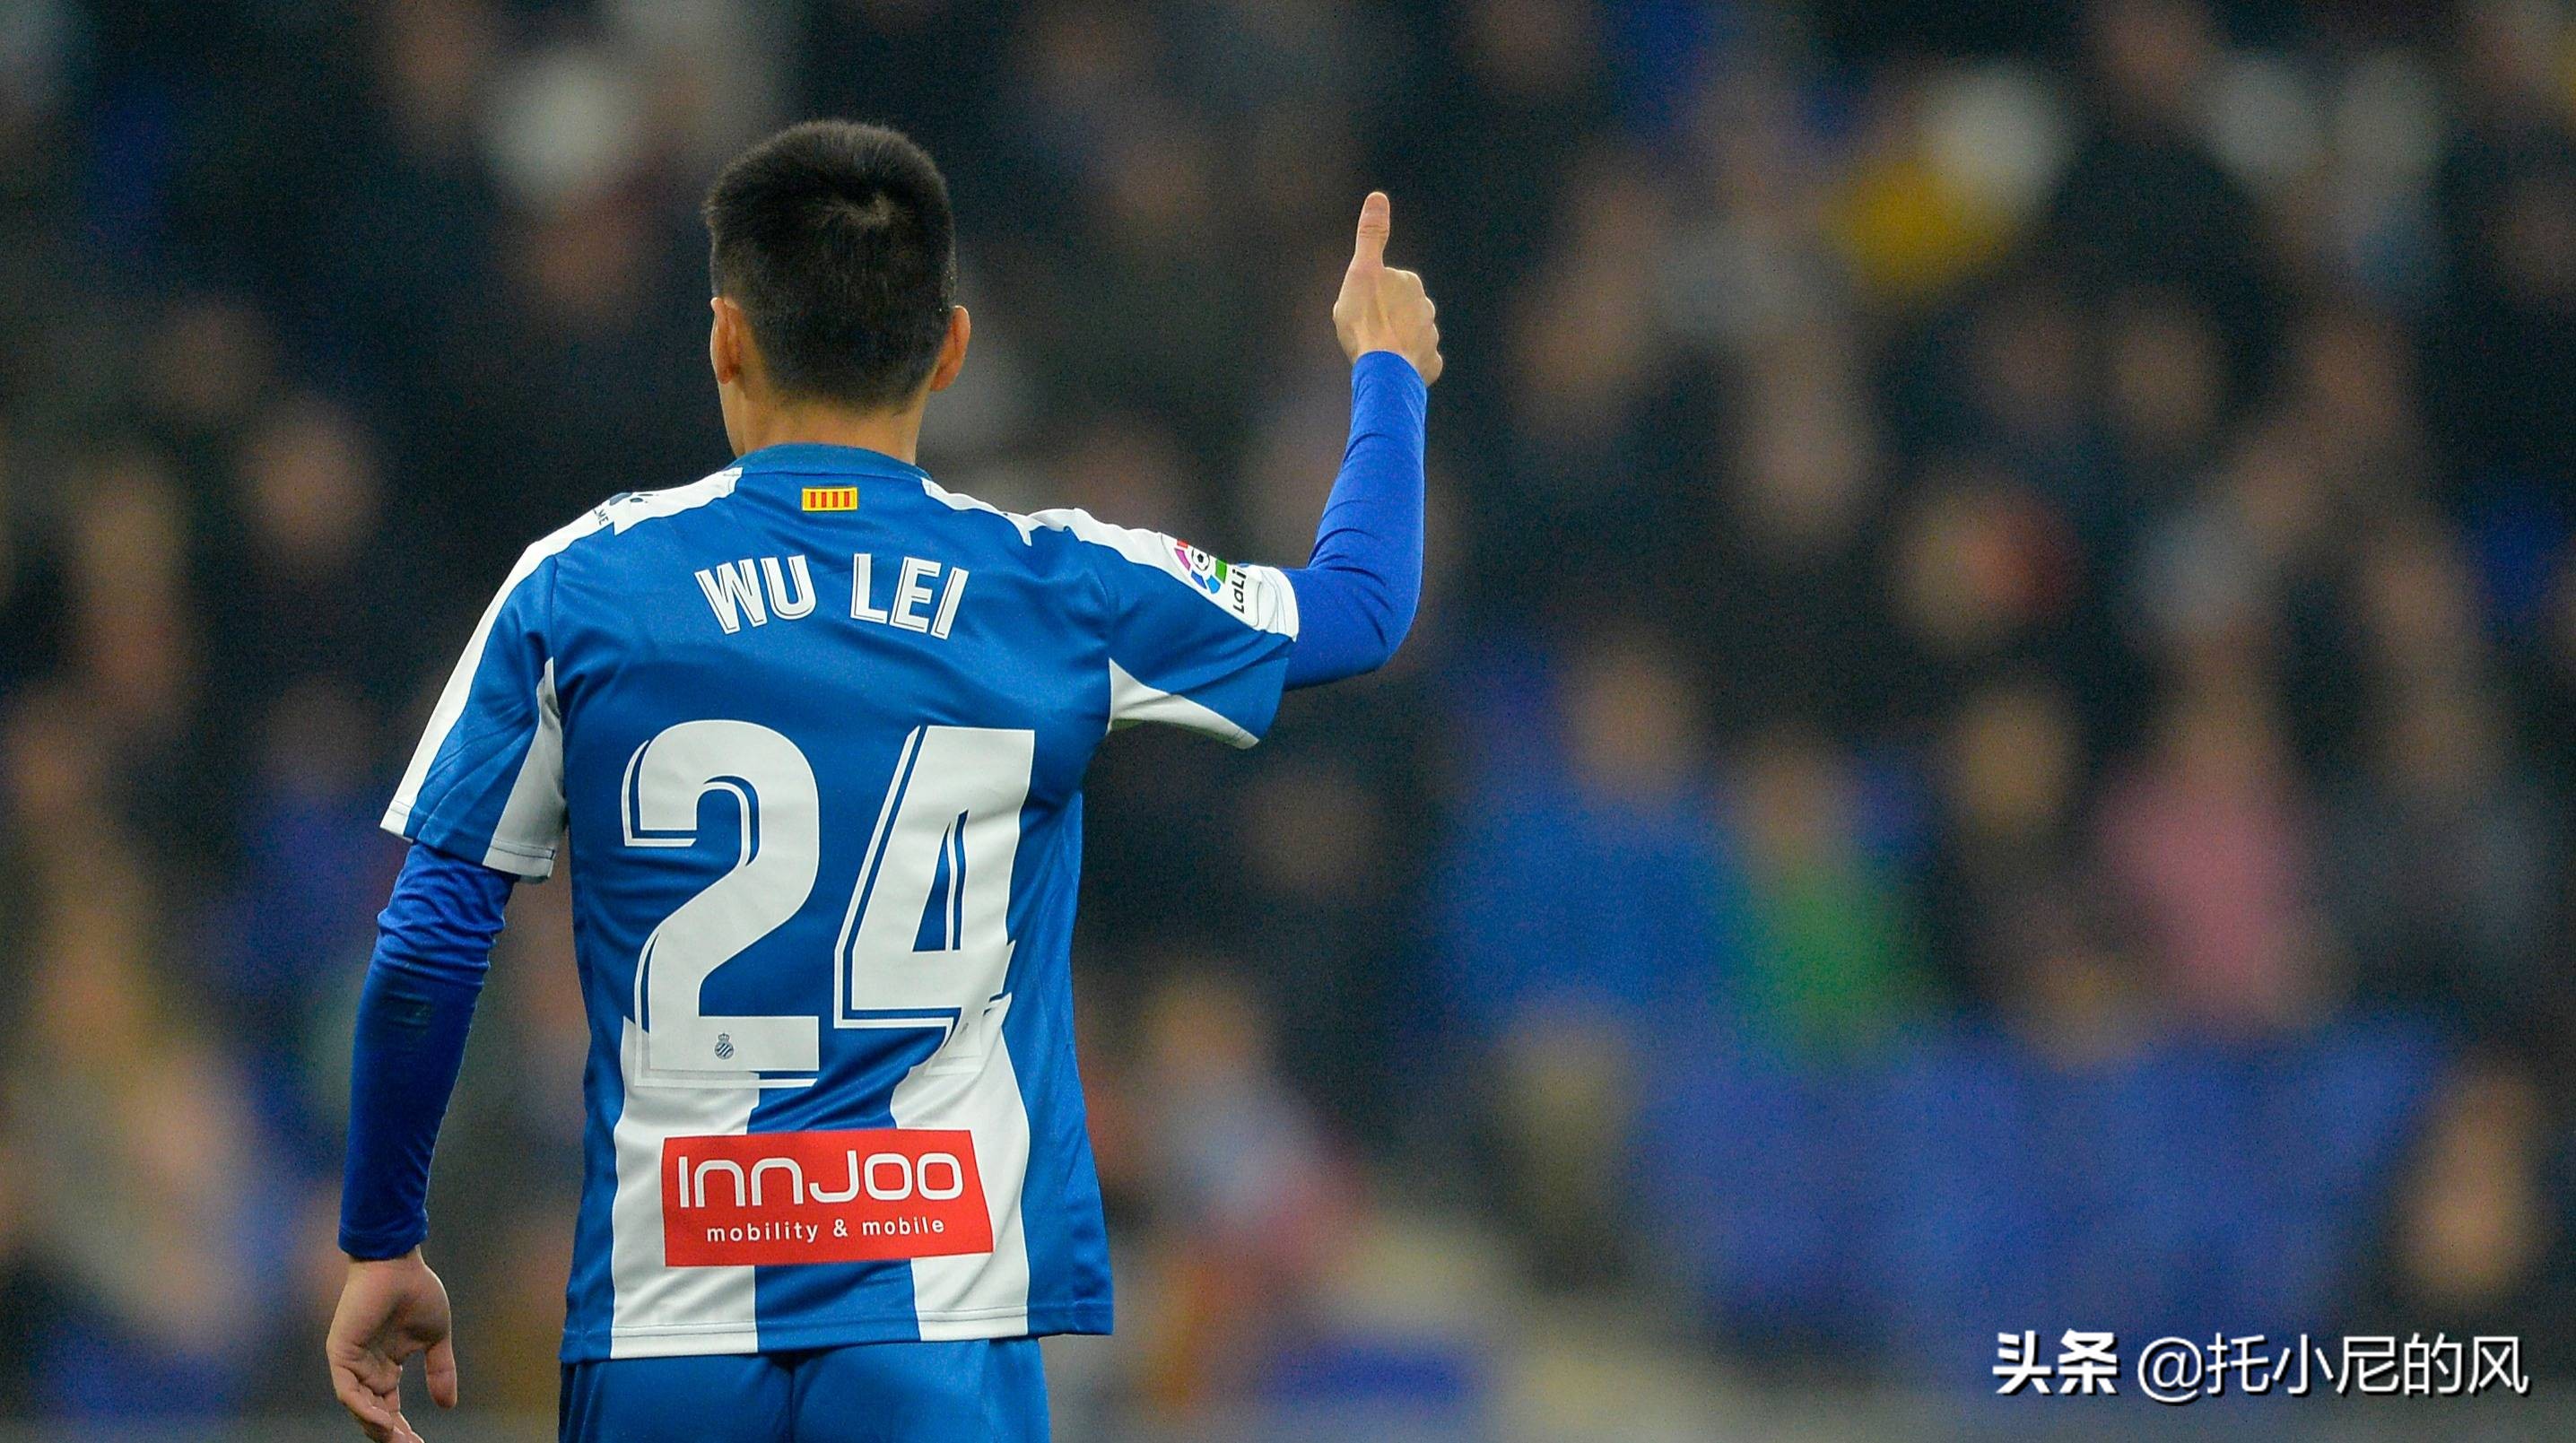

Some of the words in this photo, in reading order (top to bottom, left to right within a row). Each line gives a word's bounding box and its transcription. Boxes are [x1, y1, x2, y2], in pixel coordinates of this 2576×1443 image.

[694, 555, 817, 635] WU
[850, 553, 970, 639] LEI
[621, 719, 1035, 1089] 24
[706, 1221, 818, 1243] mobility
[832, 1218, 849, 1238] &
[862, 1216, 945, 1236] mobile
